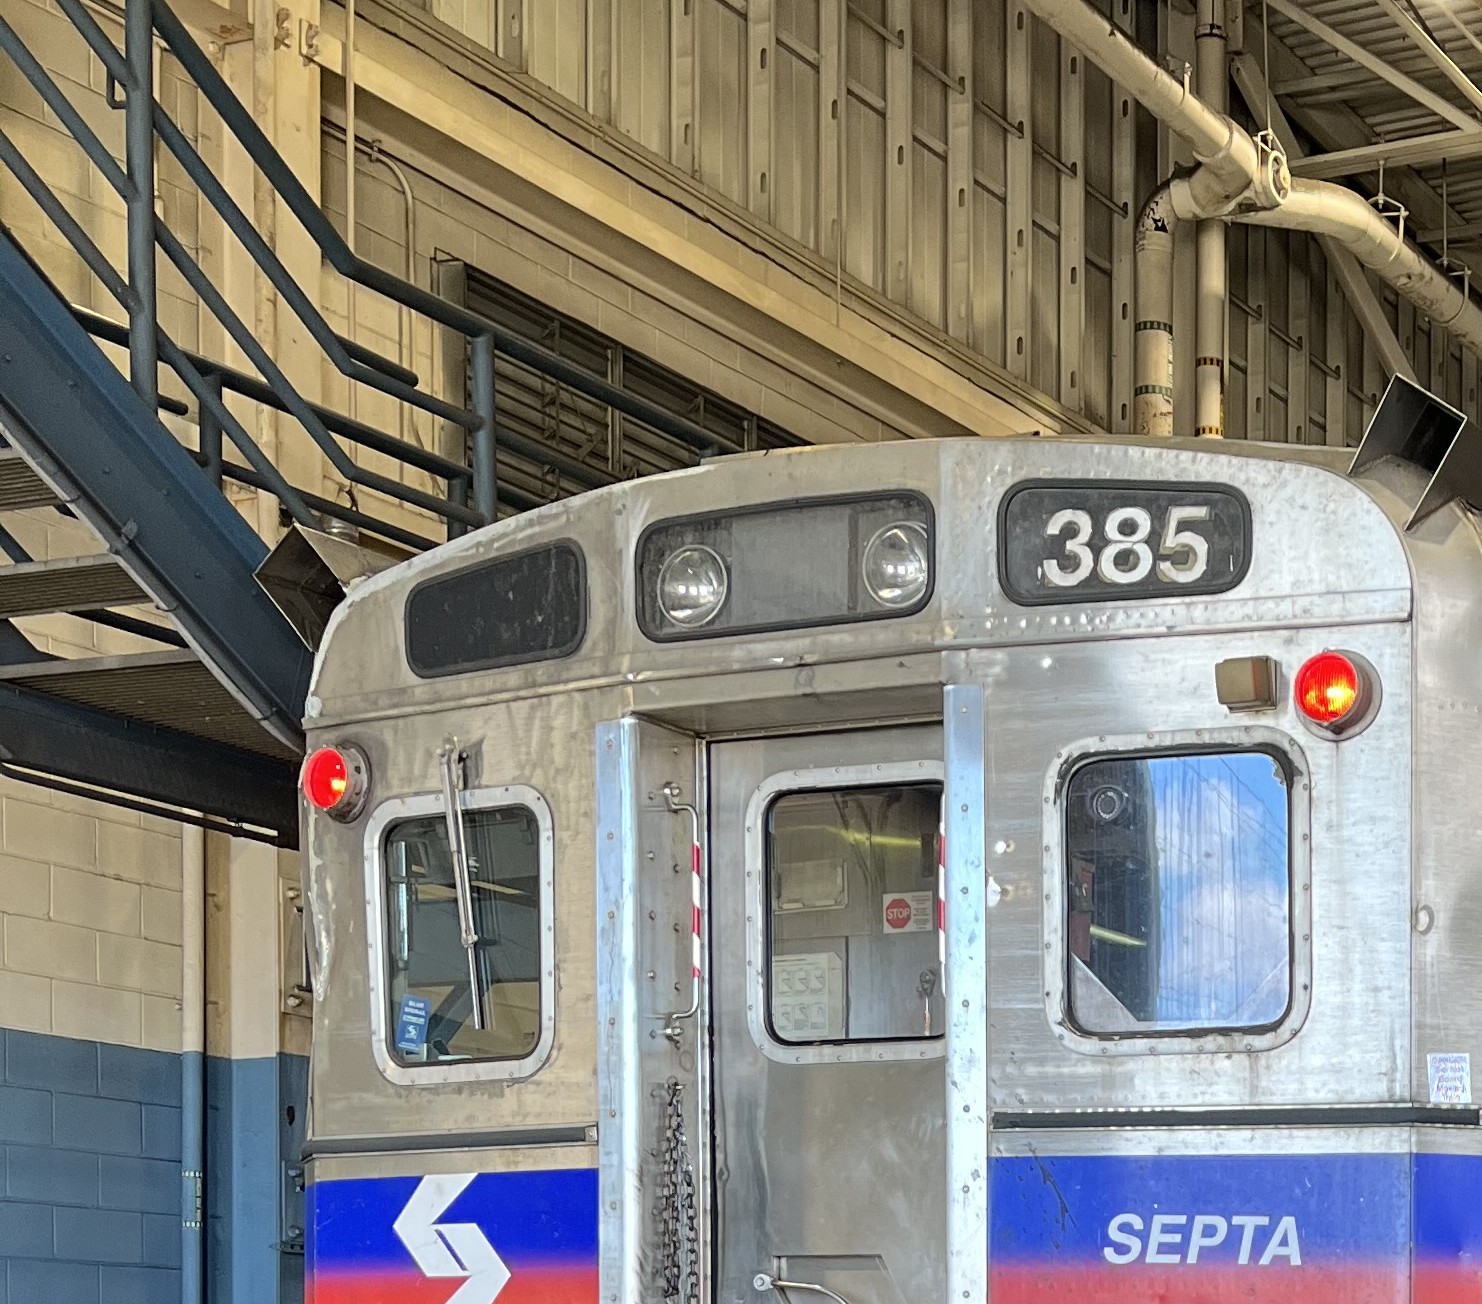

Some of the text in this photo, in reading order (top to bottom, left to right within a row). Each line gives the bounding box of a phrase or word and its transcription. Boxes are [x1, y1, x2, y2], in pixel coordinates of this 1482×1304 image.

[1043, 504, 1210, 588] 385
[886, 907, 911, 920] STOP
[1103, 1213, 1302, 1266] SEPTA
